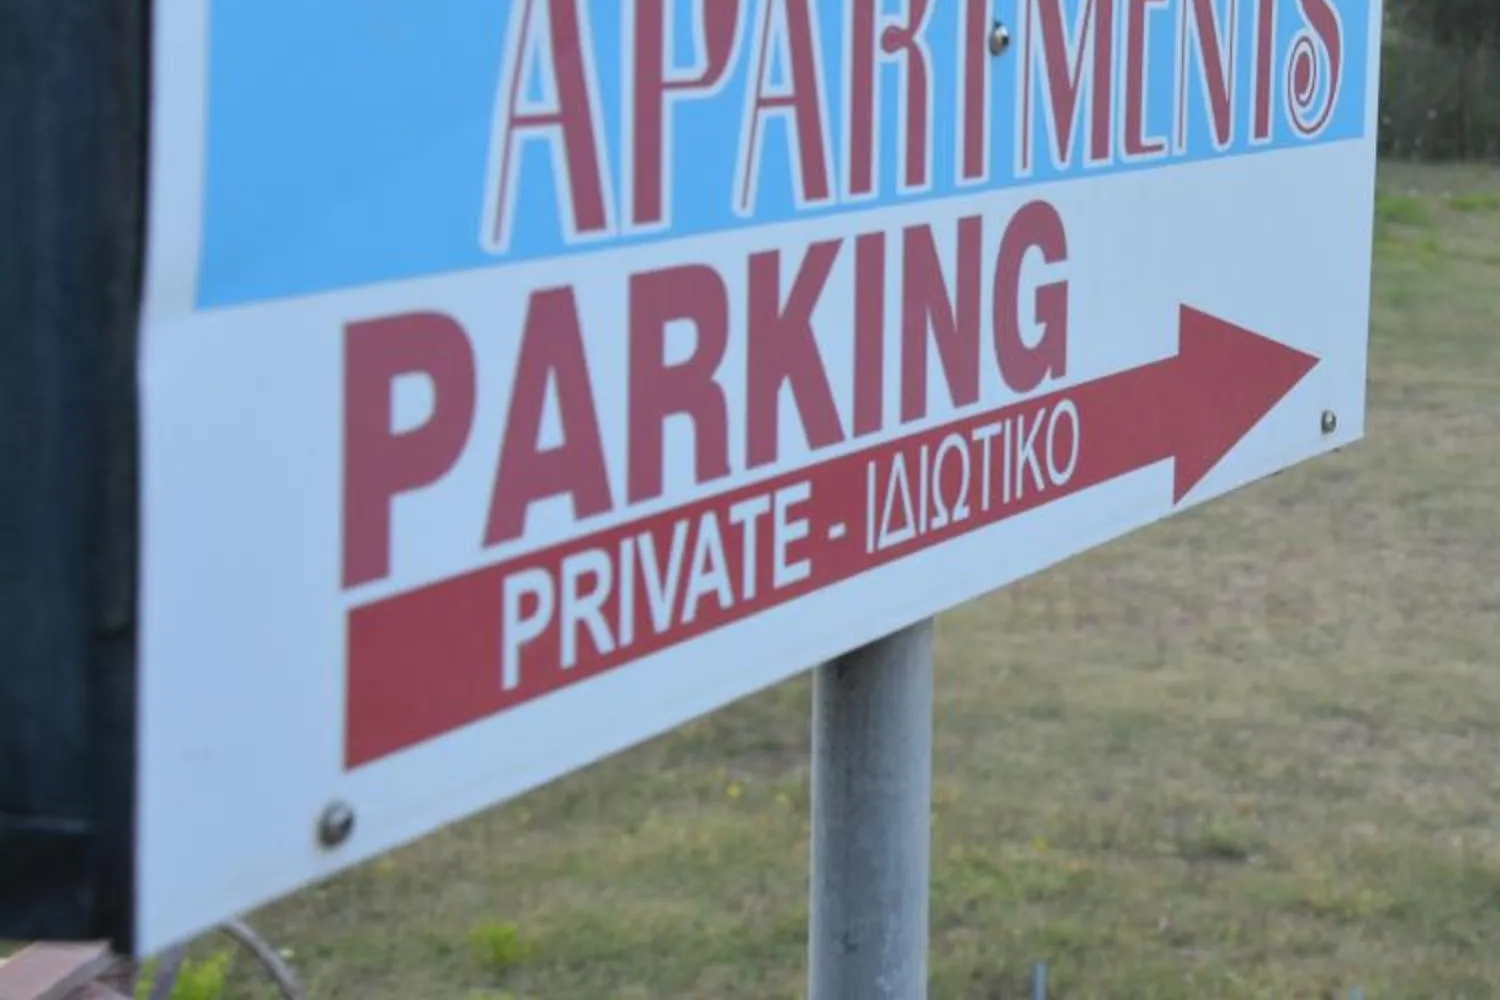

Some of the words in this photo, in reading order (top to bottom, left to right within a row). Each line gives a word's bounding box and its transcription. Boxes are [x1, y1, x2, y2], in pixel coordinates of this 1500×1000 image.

[342, 199, 1069, 591] PARKING
[500, 482, 813, 692] PRIVATE
[866, 398, 1080, 555] ΙΔΙΩΤΙΚΟ
